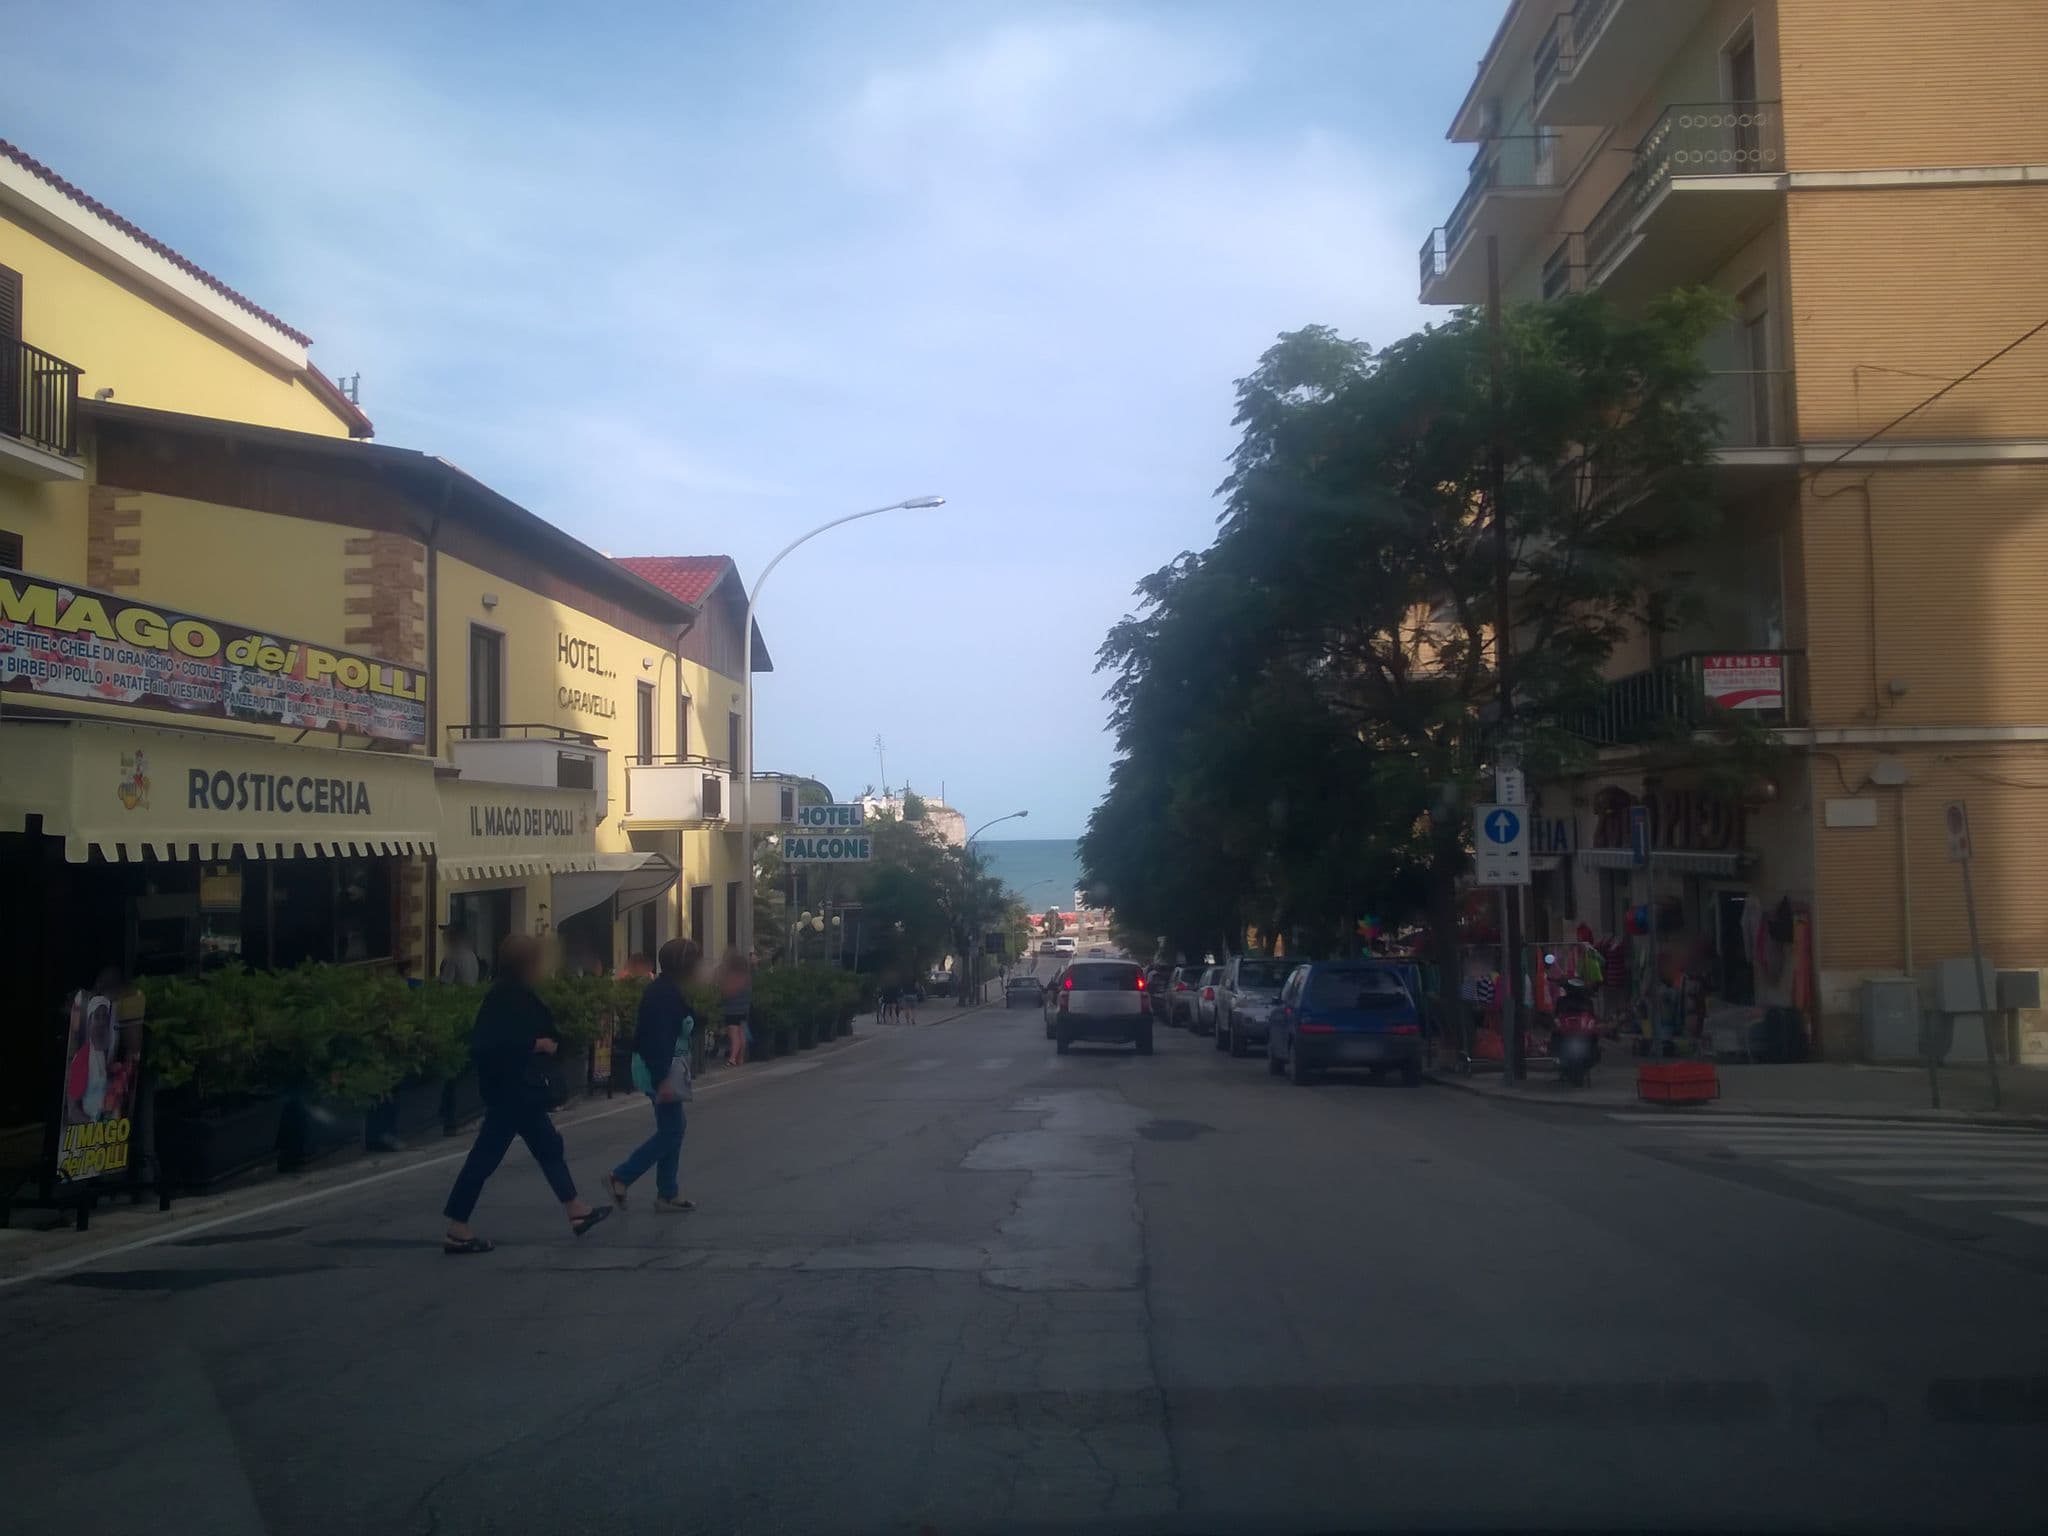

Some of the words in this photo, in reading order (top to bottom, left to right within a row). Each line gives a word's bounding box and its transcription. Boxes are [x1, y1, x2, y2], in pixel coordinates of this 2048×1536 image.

[0, 579, 221, 658] MAGO
[225, 635, 298, 675] dei
[306, 647, 426, 702] POLLI
[60, 639, 100, 659] CHELE
[103, 646, 114, 661] DI
[117, 649, 174, 672] GRANCHIO
[1713, 656, 1772, 668] VENDE
[8, 656, 46, 676] BIRBE
[50, 663, 61, 679] DI
[65, 666, 103, 684] POLLO
[113, 673, 150, 691] PATATE
[152, 681, 169, 694] alla
[172, 682, 216, 702] VIESTANA
[558, 686, 616, 719] CARAVELLA
[188, 768, 371, 816] ROSTICCERIA
[470, 805, 482, 837] IL
[485, 806, 521, 837] MAGO
[524, 807, 543, 836] DEI
[545, 808, 574, 836] POLLI
[798, 807, 861, 826] HOTEL
[784, 838, 870, 859] FALCONE
[78, 1118, 131, 1147] MAGO
[86, 1143, 129, 1172] POLLI
